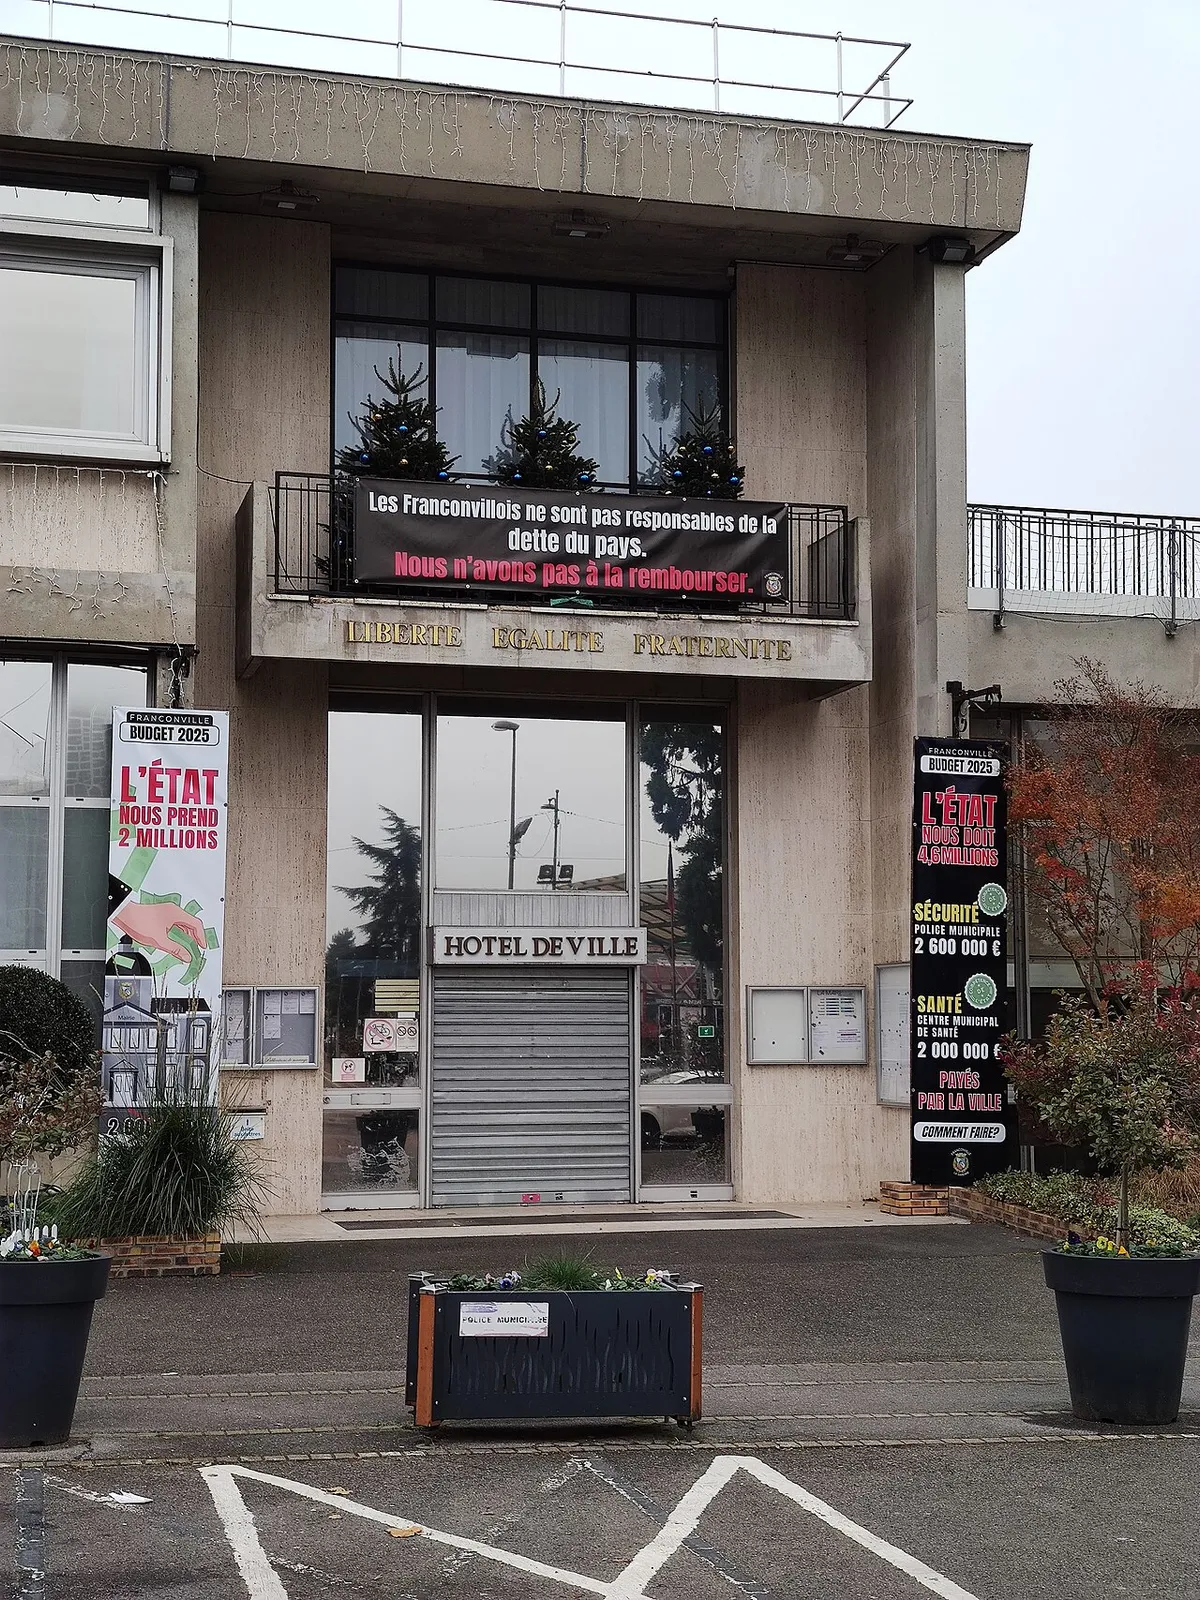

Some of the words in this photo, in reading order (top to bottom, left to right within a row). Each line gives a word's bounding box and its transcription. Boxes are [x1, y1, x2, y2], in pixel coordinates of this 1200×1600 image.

[368, 491, 399, 513] Les
[402, 493, 522, 521] Franconvillois
[525, 503, 547, 523] ne
[550, 504, 588, 525] sont
[591, 508, 622, 528] pas
[625, 509, 735, 532] responsables
[738, 514, 758, 534] de
[762, 515, 777, 534] la
[508, 527, 560, 552] dette
[565, 530, 590, 555] du
[595, 535, 647, 559] pays.
[394, 551, 448, 579] Nous
[454, 555, 537, 583] n'avons
[542, 562, 580, 588] pas
[586, 559, 599, 586] à
[604, 562, 623, 588] la
[628, 565, 754, 594] rembourser.
[346, 620, 463, 648] LIBERTE
[491, 626, 605, 653] EGALITE
[633, 633, 792, 661] FRATERNITE
[129, 713, 210, 725] FRANCONVILLE
[130, 725, 174, 741] BUDGET
[177, 728, 210, 743] 2025
[928, 747, 993, 757] FRANCONVILLE
[929, 758, 964, 772] BUDGET
[967, 760, 993, 774] 2025
[120, 758, 219, 805] L'ÉTAT
[119, 805, 162, 826] NOUS
[167, 807, 219, 828] PREND
[922, 785, 998, 828] L'ÉTAT
[118, 827, 130, 847] 2
[136, 828, 218, 850] MILLIONS
[922, 825, 960, 845] NOUS
[963, 827, 996, 847] DOIT
[914, 898, 979, 924] SÉCURITÉ
[914, 924, 946, 935] POLICE
[949, 925, 1001, 937] MUNICIPALE
[443, 936, 528, 957] HOTEL
[531, 936, 564, 957] DE
[566, 936, 639, 957] VILLE
[914, 937, 924, 954] 2
[929, 937, 956, 955] 600
[961, 938, 988, 956] 000
[992, 940, 1001, 957] €
[917, 992, 962, 1014] SANTÉ
[917, 1015, 950, 1026] CENTRE
[952, 1015, 999, 1027] MUNICIPAL
[917, 1026, 929, 1037] DE
[931, 1026, 959, 1038] SANTÉ
[917, 1041, 927, 1058] 2
[931, 1041, 958, 1059] 000
[963, 1042, 989, 1060] 000
[939, 1067, 980, 1089] PAYÉS
[918, 1092, 945, 1110] PAR
[948, 1093, 965, 1111] LA
[968, 1093, 1002, 1112] VILLE
[921, 1125, 969, 1139] COMMENT
[969, 1126, 1000, 1139] FAIRE?
[462, 1316, 491, 1324] POLICE
